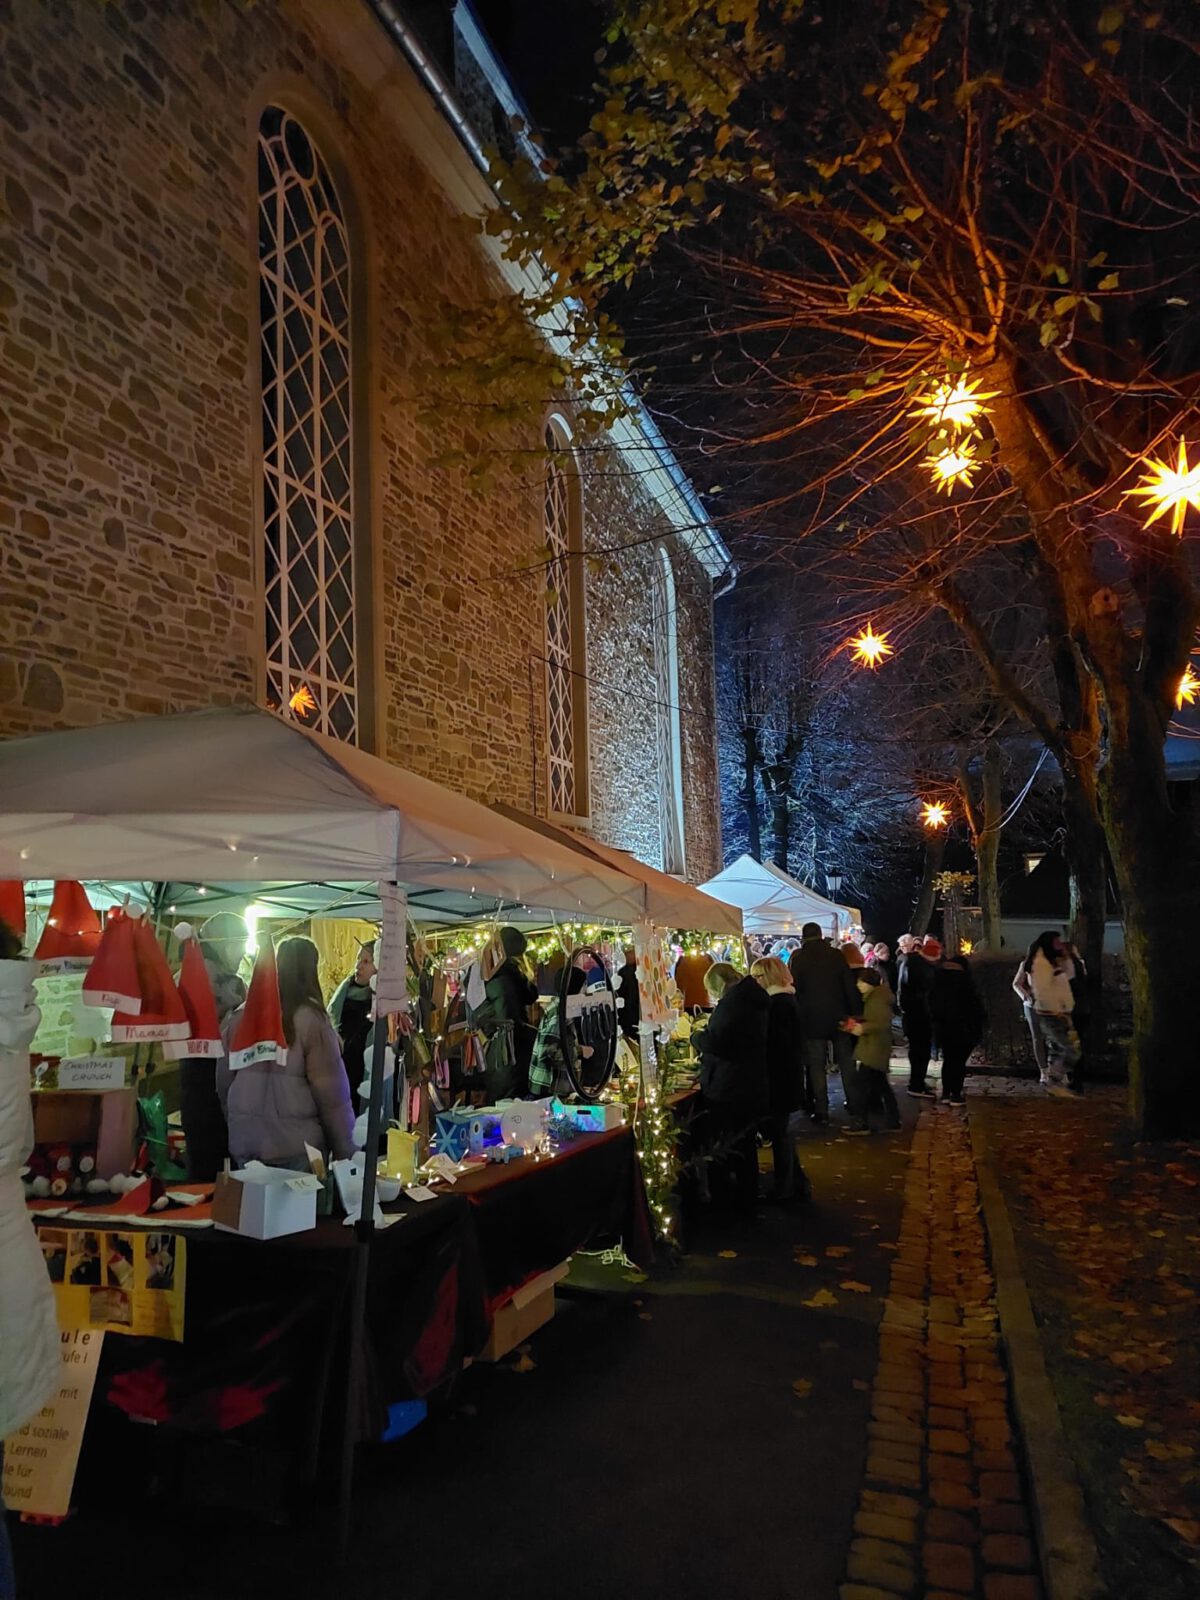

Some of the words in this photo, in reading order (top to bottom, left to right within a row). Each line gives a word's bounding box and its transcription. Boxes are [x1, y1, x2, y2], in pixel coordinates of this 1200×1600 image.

[63, 1061, 113, 1071] CHRISTMAS
[61, 1329, 91, 1345] ule
[62, 1350, 81, 1363] ufe
[60, 1388, 78, 1400] mit
[40, 1407, 55, 1418] en
[18, 1423, 31, 1436] nd
[32, 1426, 69, 1440] soziale
[10, 1442, 48, 1458] Lernen
[4, 1462, 14, 1476] le
[4, 1482, 33, 1498] bund
